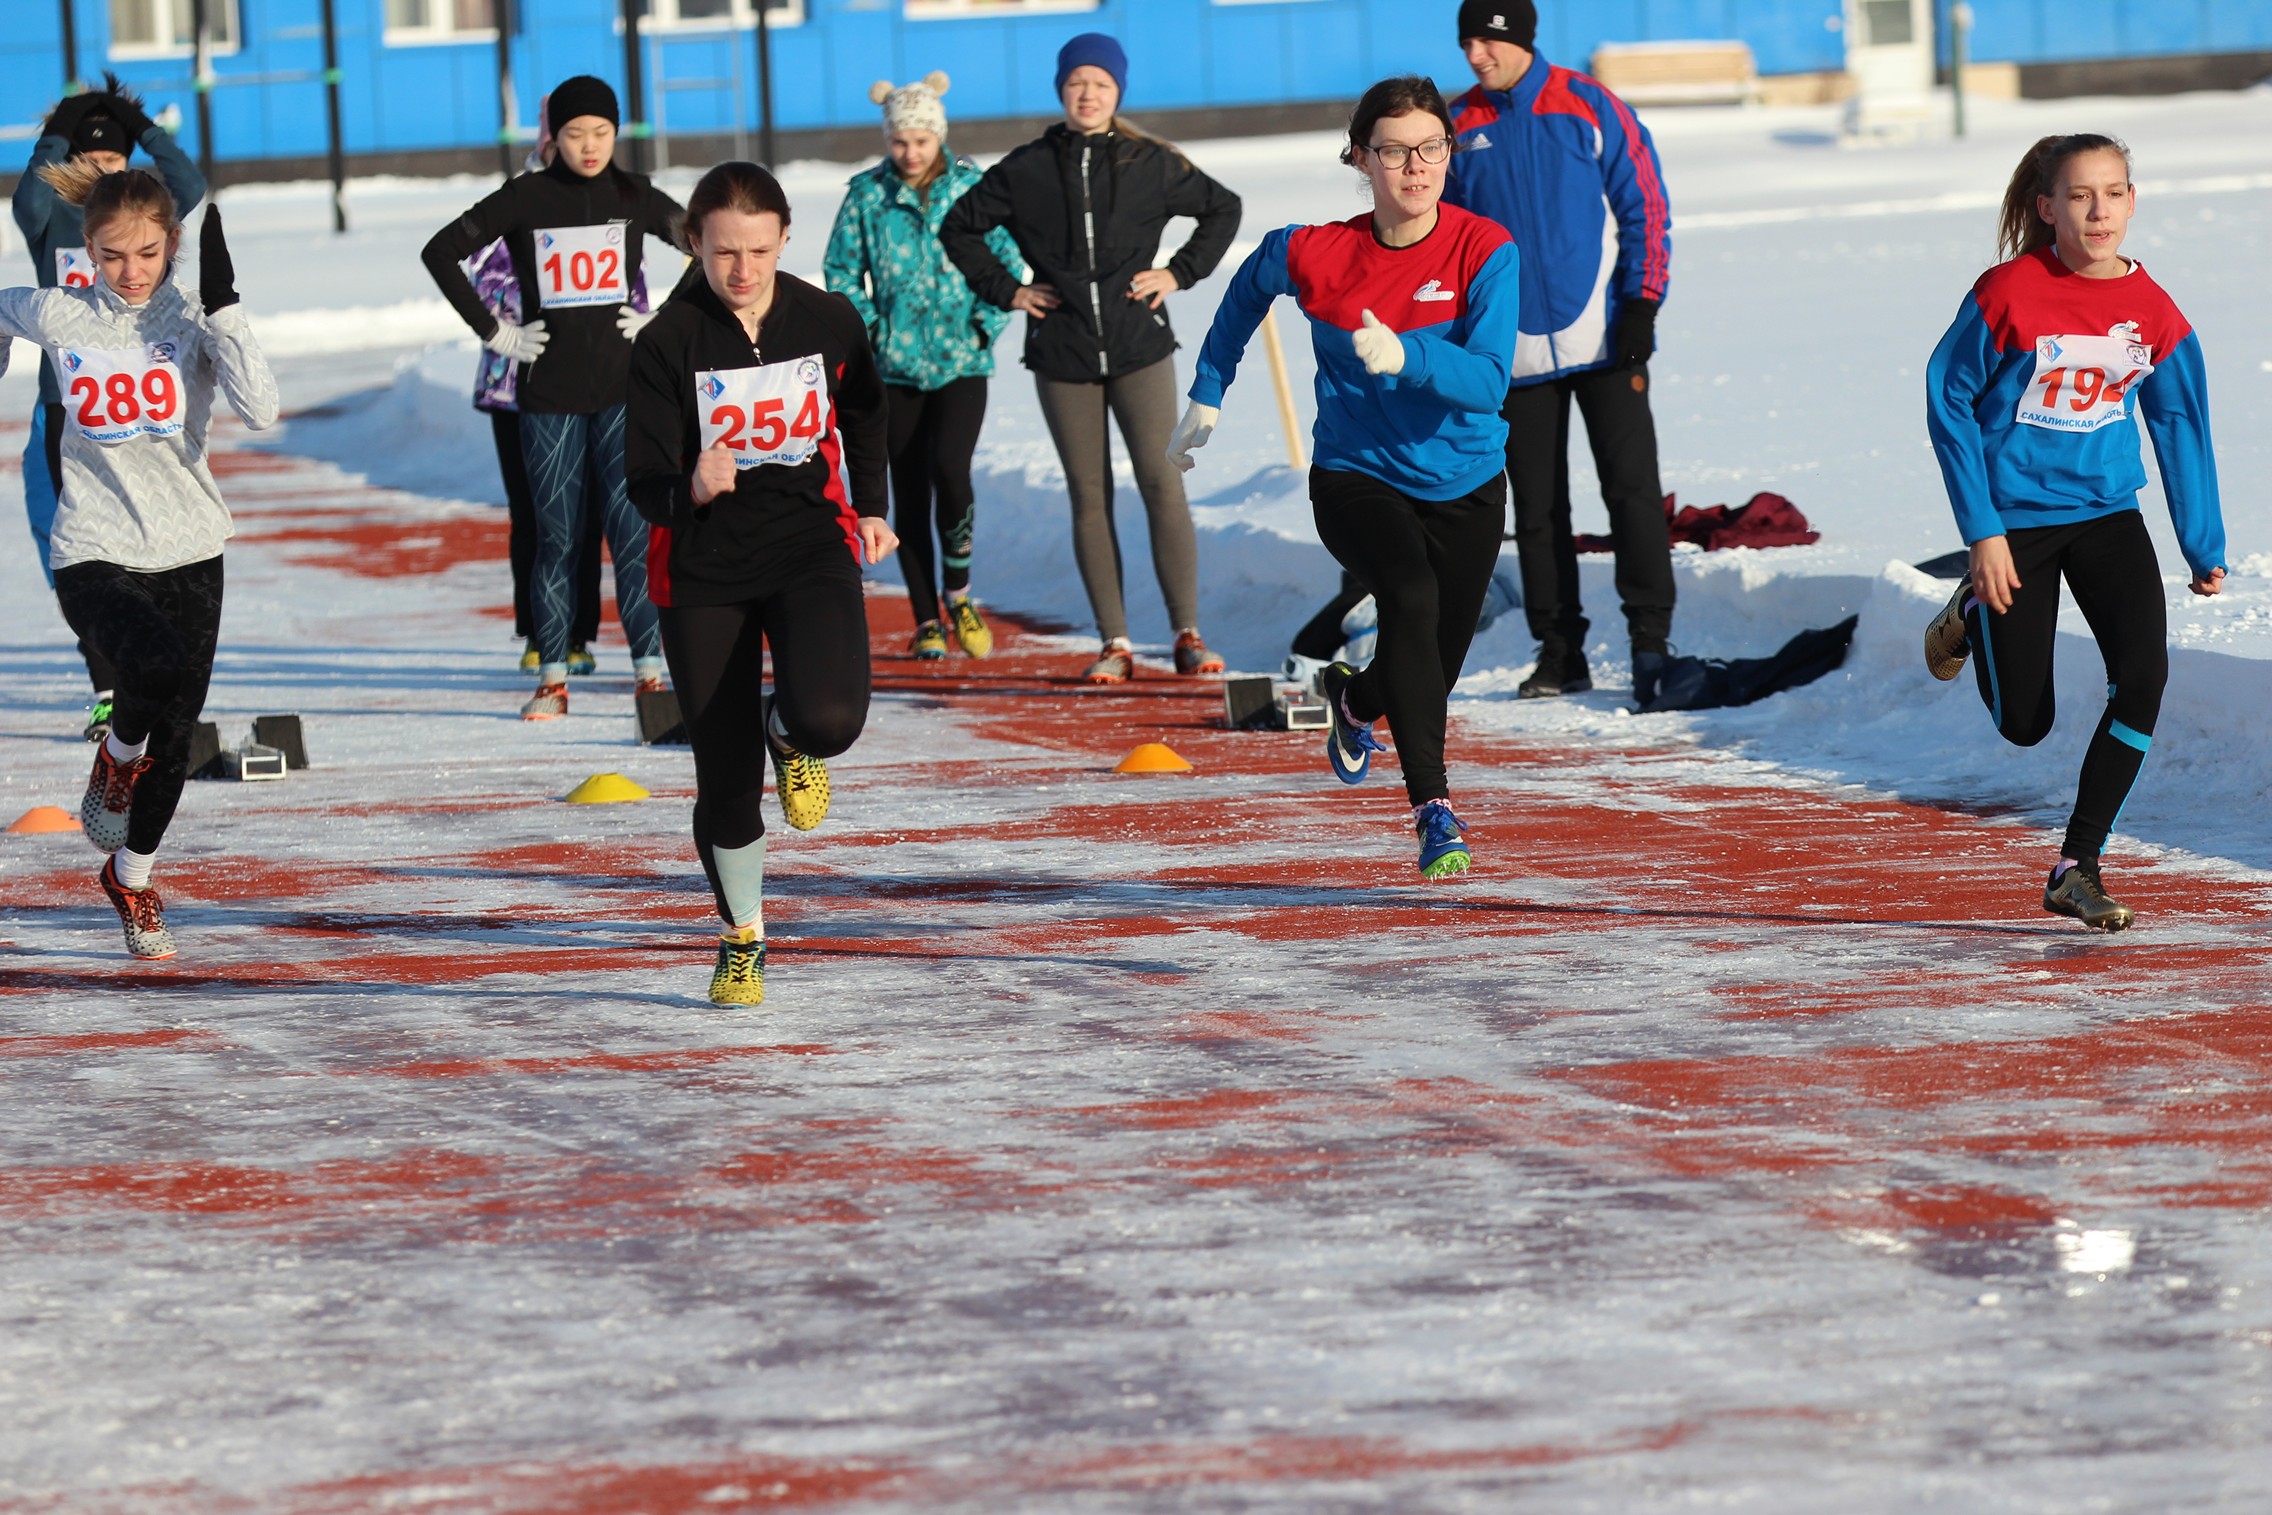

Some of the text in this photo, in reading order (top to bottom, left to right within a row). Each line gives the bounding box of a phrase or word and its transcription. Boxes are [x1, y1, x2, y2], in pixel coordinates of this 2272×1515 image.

[543, 248, 619, 292] 102
[70, 368, 177, 428] 289
[2037, 366, 2141, 412] 194
[710, 389, 821, 451] 254
[2021, 411, 2094, 428] САХАЛИНСКАЯ
